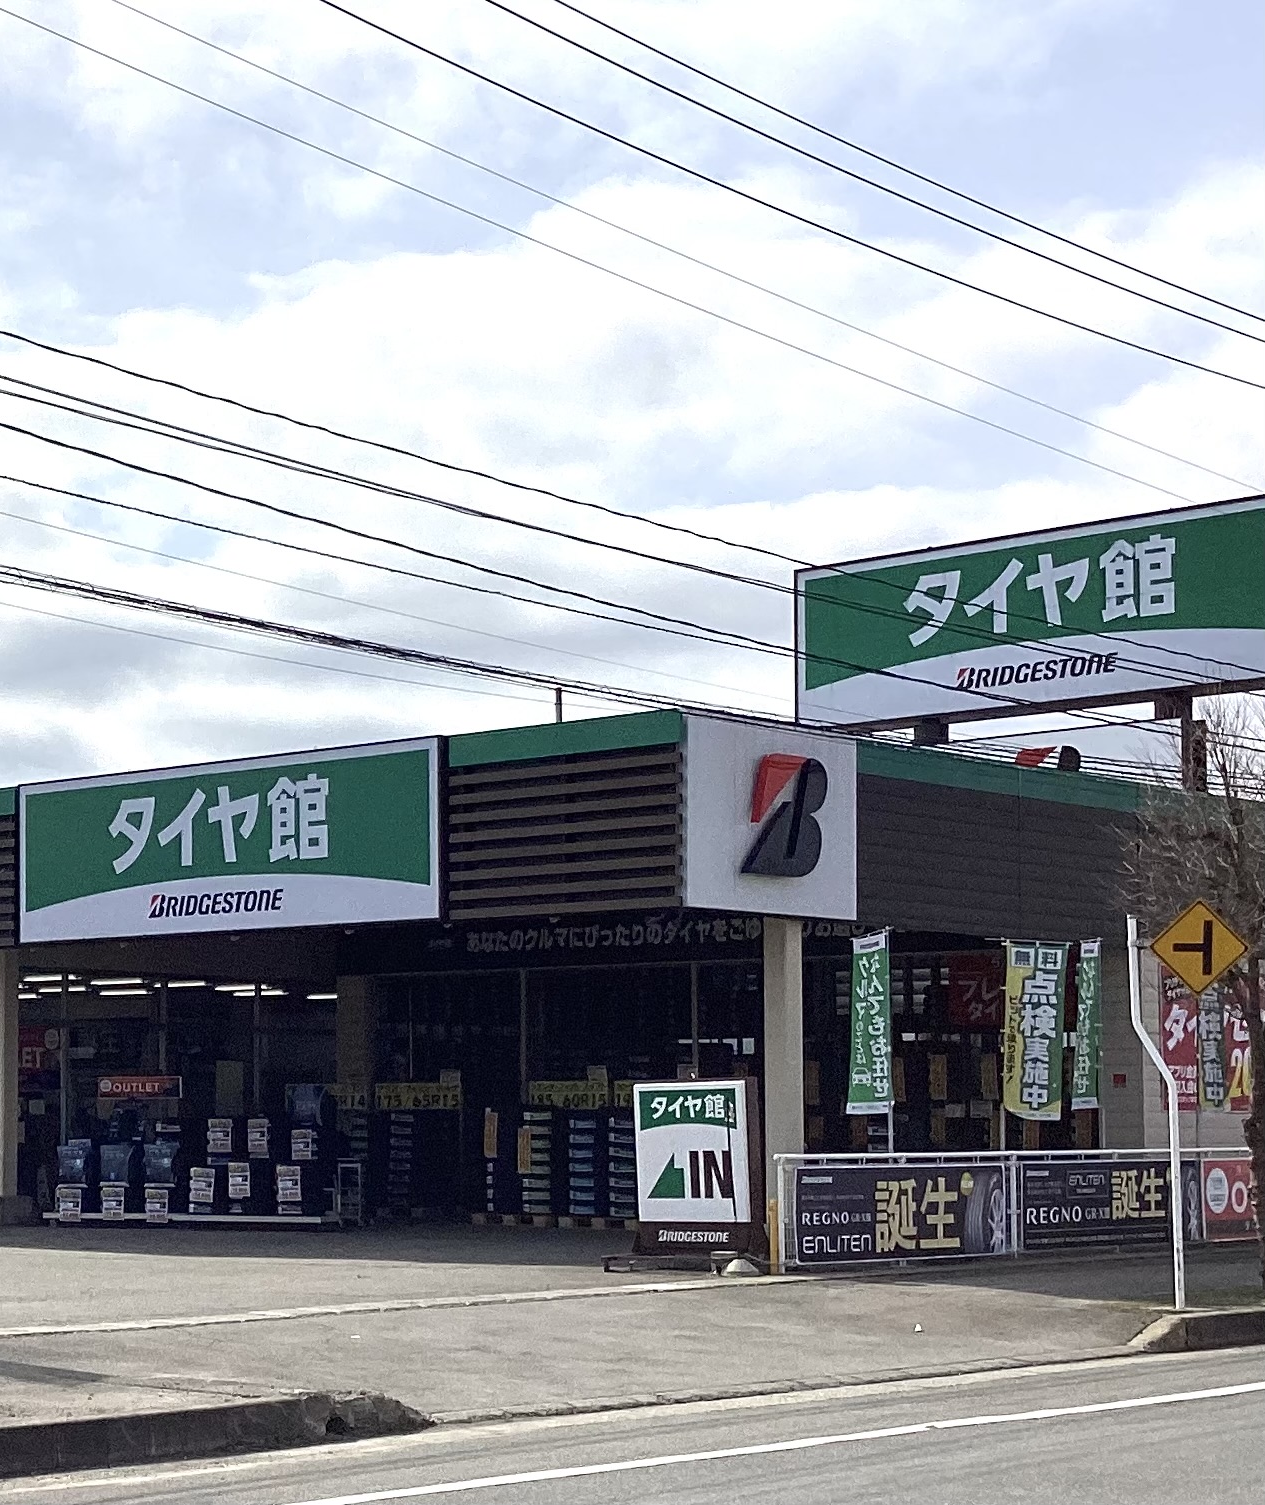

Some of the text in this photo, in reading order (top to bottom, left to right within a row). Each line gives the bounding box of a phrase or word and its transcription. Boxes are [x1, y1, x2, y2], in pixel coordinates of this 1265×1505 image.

[902, 533, 1176, 648] タイヤ館
[955, 652, 1119, 690] BRIDGESTONE
[107, 773, 330, 875] タイヤ館
[148, 888, 284, 919] BRIDGESTONE
[1020, 971, 1058, 1109] 点検実施中
[113, 1080, 160, 1093] OUTLET
[650, 1094, 725, 1120] タイヤ館
[689, 1150, 734, 1199] IN
[1111, 1167, 1166, 1220] 誕生
[801, 1211, 850, 1226] REGNO
[875, 1176, 961, 1253] 誕生
[1026, 1206, 1082, 1225] REGNO
[658, 1229, 731, 1243] BRIDGESTONE
[802, 1234, 872, 1254] ENLITEN
